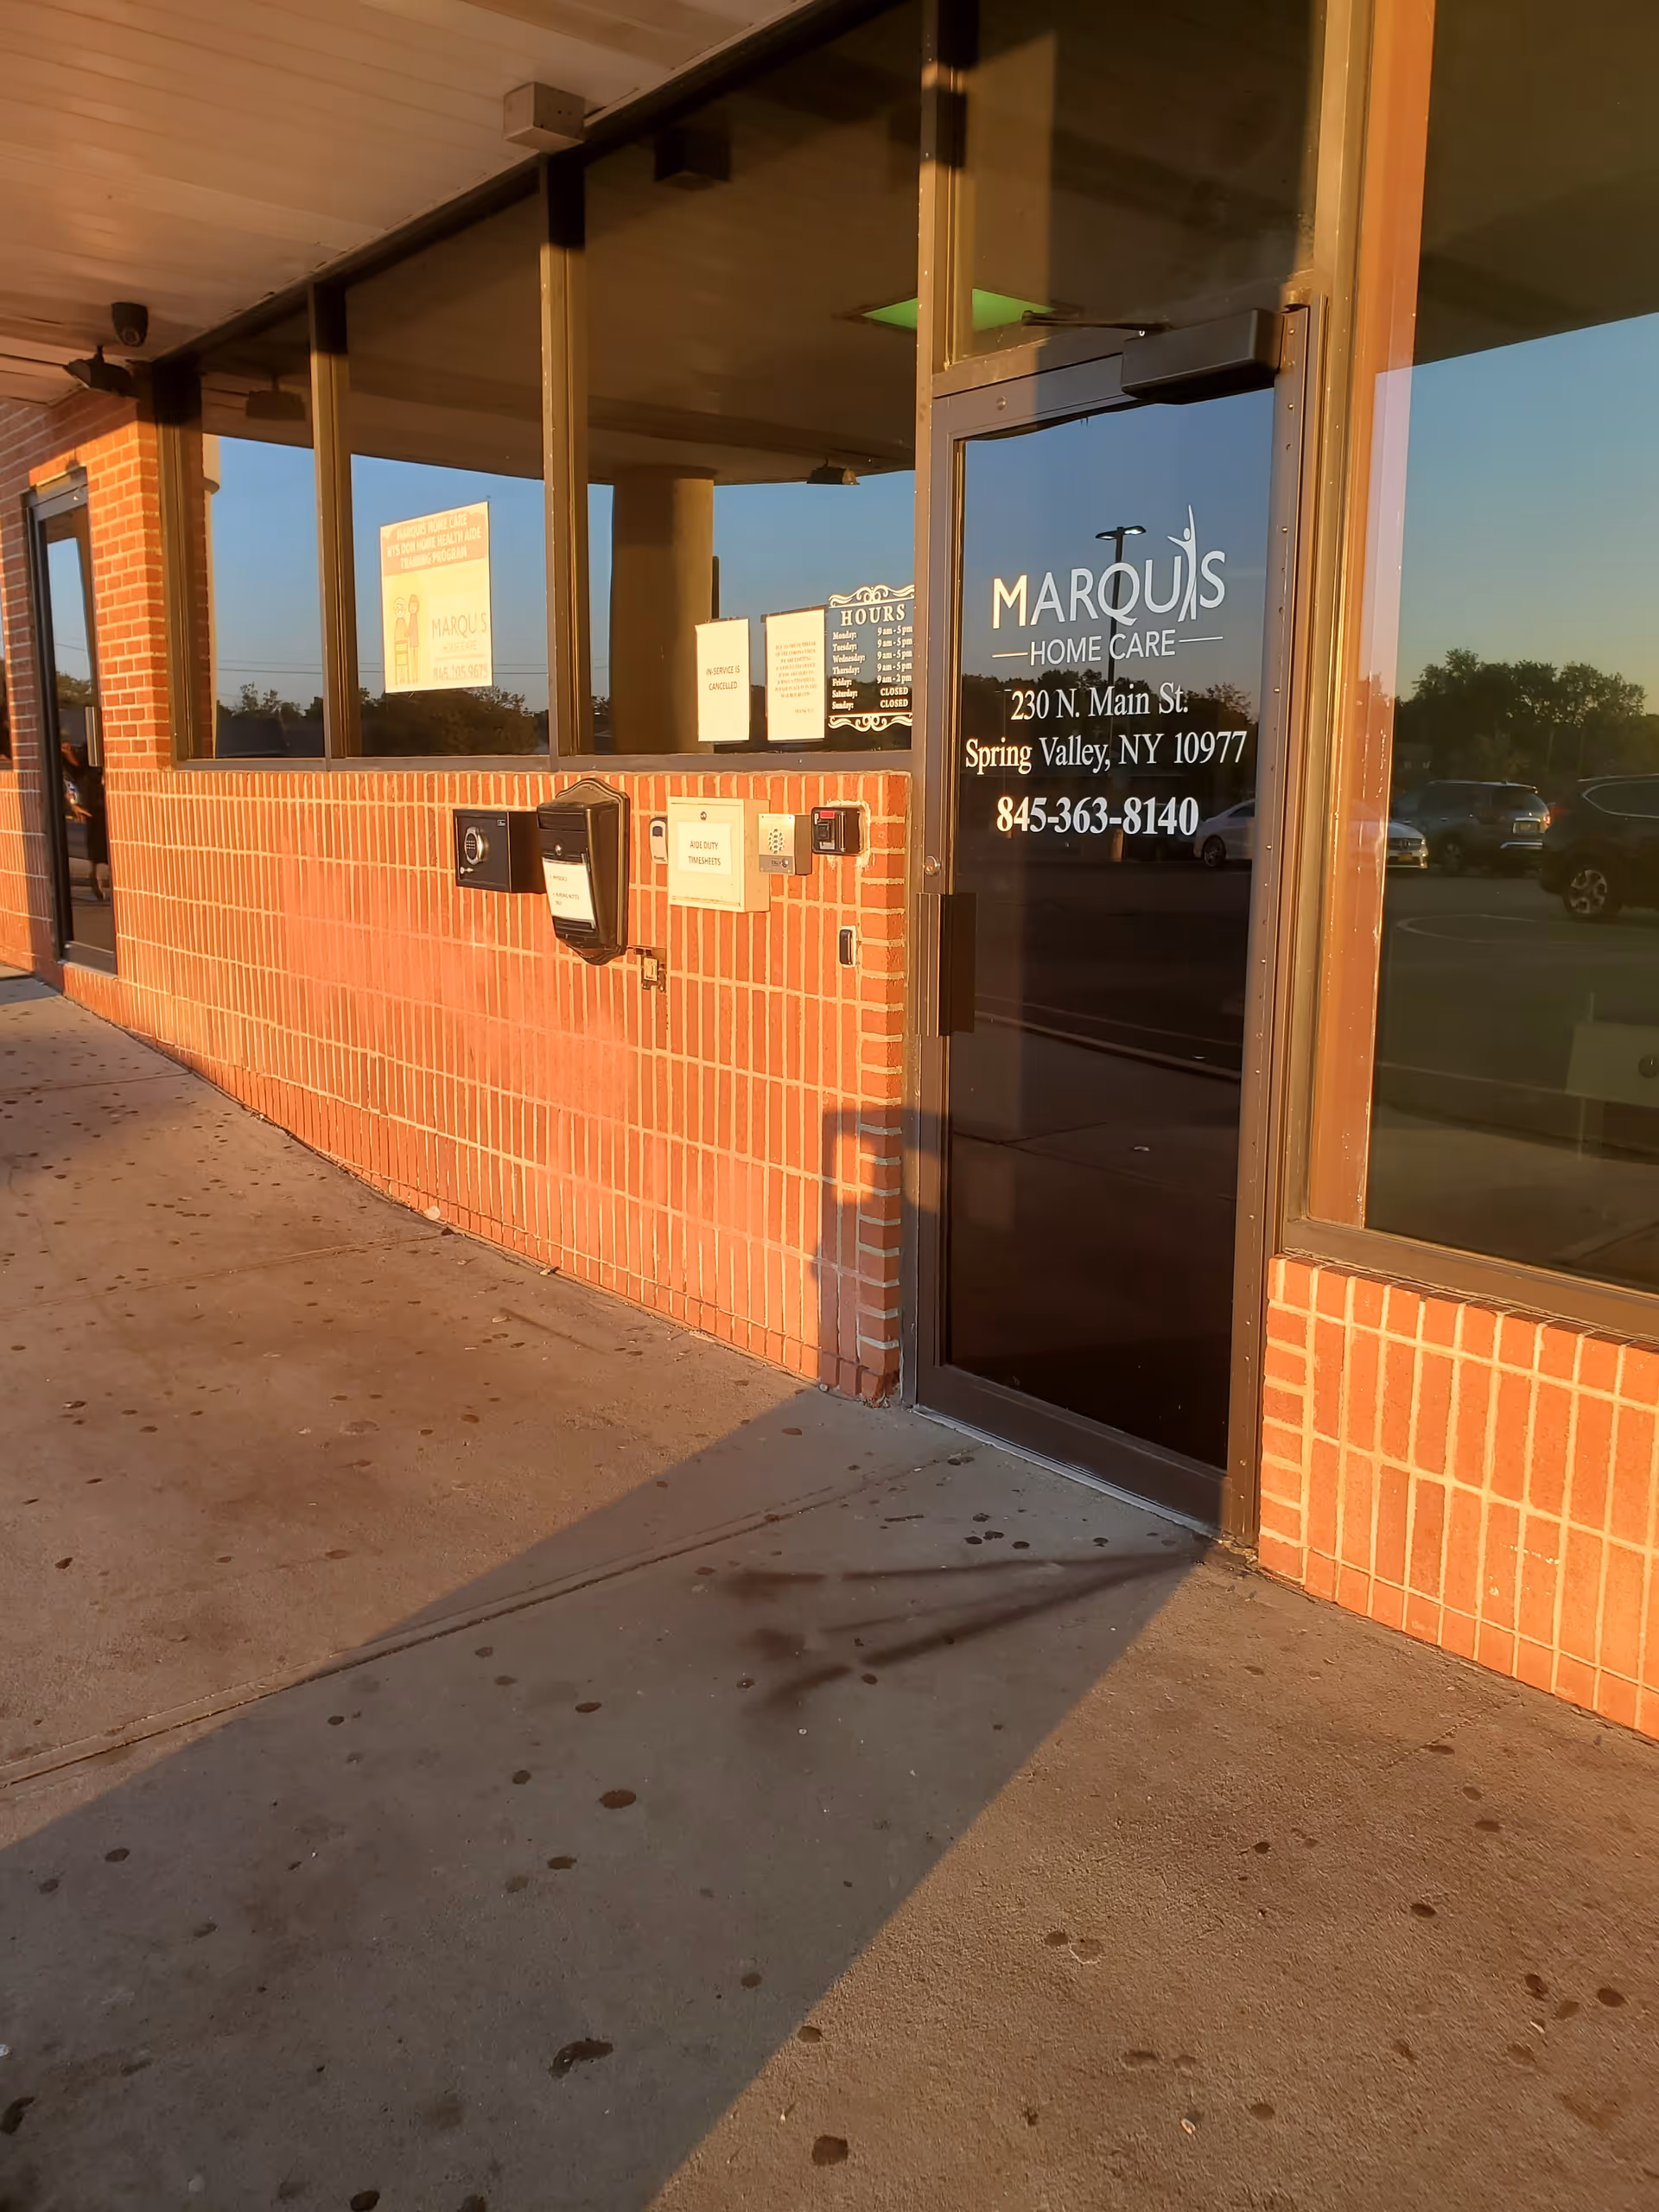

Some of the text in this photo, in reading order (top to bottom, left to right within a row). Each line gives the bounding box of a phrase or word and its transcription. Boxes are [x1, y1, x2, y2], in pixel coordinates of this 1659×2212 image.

[428, 518, 448, 534] HOME
[449, 513, 467, 528] CARE
[416, 536, 436, 550] HOME
[437, 531, 463, 547] HEALTH
[465, 526, 482, 541] AIDE
[400, 545, 467, 569] TRANG PROGRAM
[992, 505, 1225, 629] MARQUIS
[840, 604, 905, 626] HOURS
[833, 630, 857, 640] Monday:
[833, 642, 857, 652] Tuesday:
[1030, 629, 1176, 666] HOME CARE
[833, 653, 865, 663] Wednesday:
[706, 665, 740, 676] IN-SERVICE IS
[832, 665, 860, 676] Thursday:
[709, 681, 738, 691] CANCELLED
[832, 677, 852, 688] Friday:
[832, 687, 908, 699] Saturday: CLOSED
[832, 699, 908, 711] Sunday: CLOSED
[1011, 681, 1188, 721] 230 N. Main St.
[966, 731, 1247, 775] Spring Valley, NY 10977
[997, 796, 1199, 836] 845-363-8140
[704, 841, 718, 850] DUTY
[688, 856, 721, 866] TIMESHEETS
